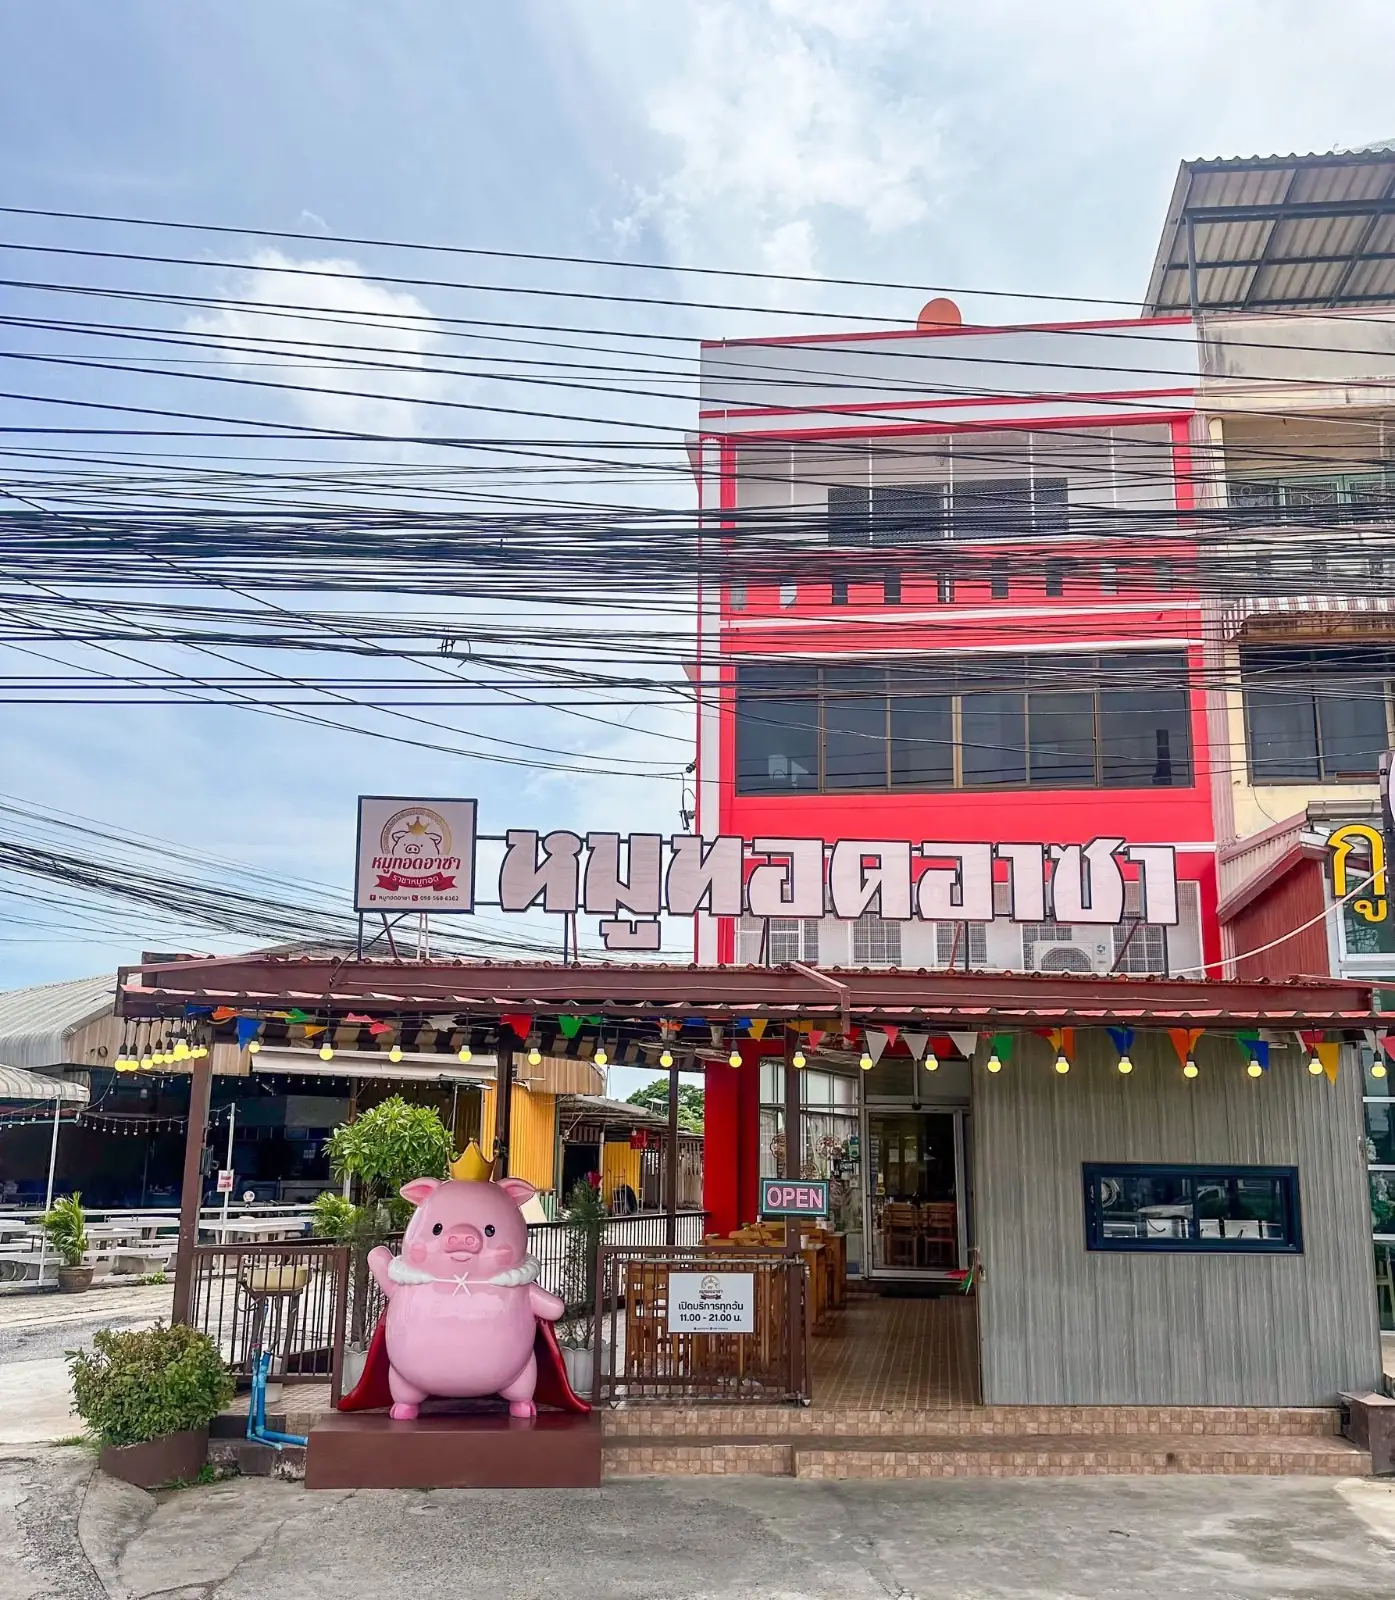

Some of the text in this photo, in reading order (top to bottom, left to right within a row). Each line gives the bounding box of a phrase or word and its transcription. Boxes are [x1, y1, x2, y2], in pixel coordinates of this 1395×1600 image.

[767, 1187, 823, 1208] OPEN
[678, 1300, 744, 1313] เปิดบริการทุกวัน
[680, 1313, 701, 1322] 11.00
[708, 1313, 732, 1322] 21.00
[734, 1314, 742, 1322] น.
